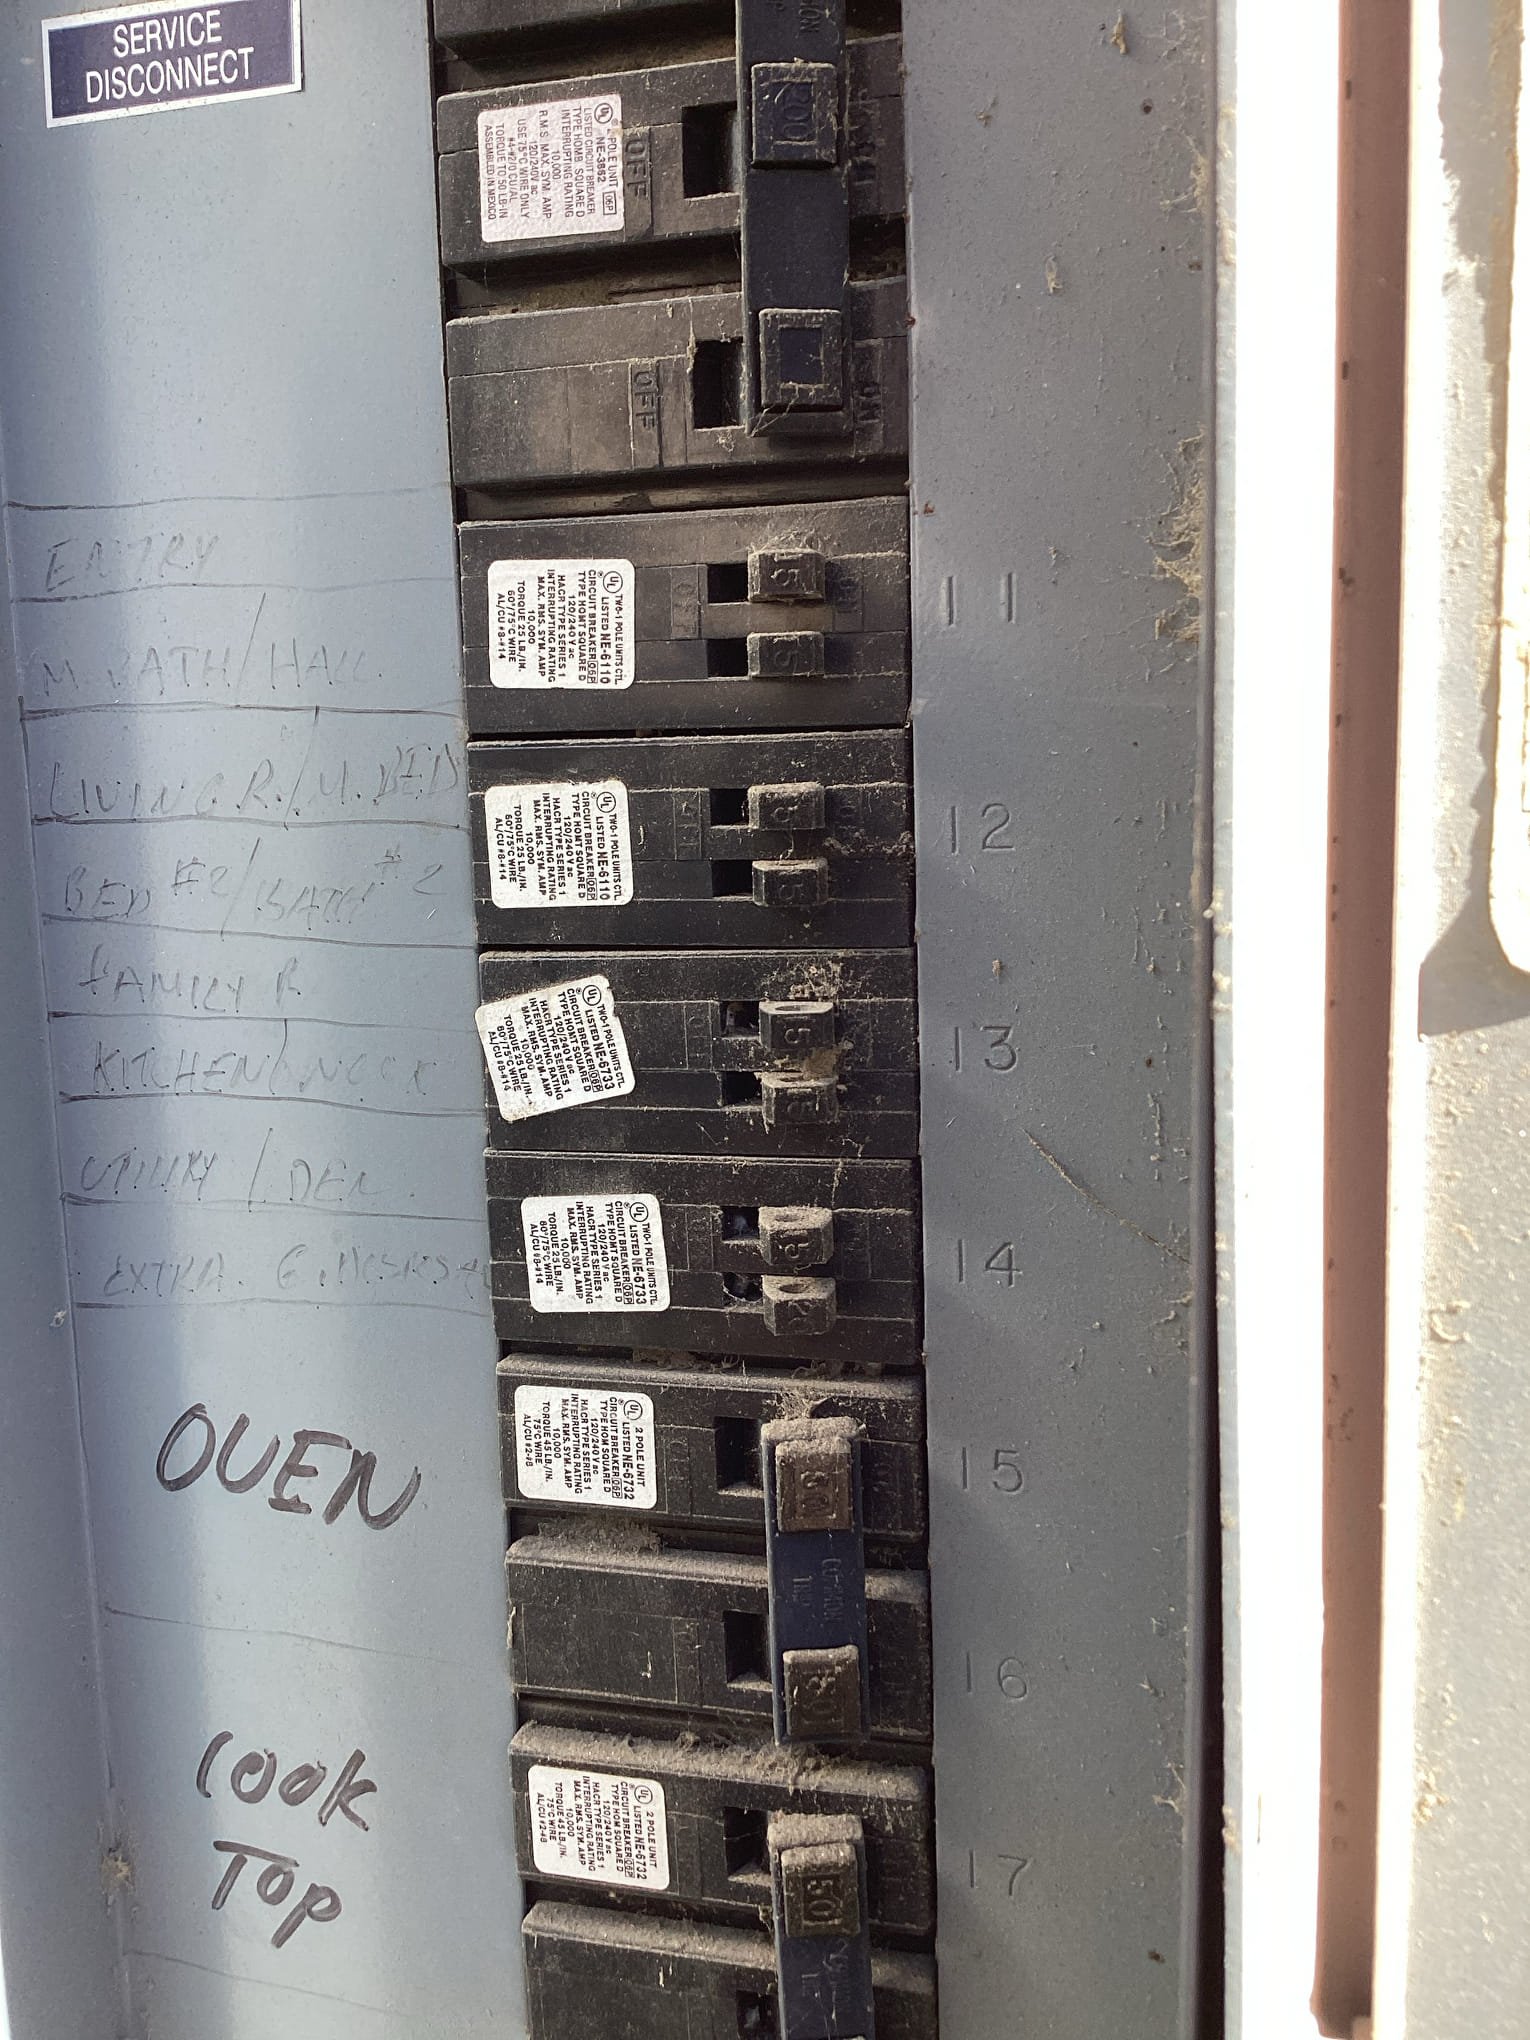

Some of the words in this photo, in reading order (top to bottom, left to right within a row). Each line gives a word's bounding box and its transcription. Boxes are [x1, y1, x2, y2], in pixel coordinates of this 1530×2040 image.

[113, 10, 222, 57] SERVICE
[86, 47, 254, 103] DISCONNECT
[584, 108, 593, 137] LISTED
[485, 125, 495, 174] ASSEMBLED
[496, 124, 505, 163] TORQUE
[562, 110, 572, 178] INTERRUPTING
[585, 140, 593, 171] CIRCUIT
[607, 138, 616, 163] POLE
[520, 166, 528, 191] WIRE
[551, 151, 561, 179] 10,000
[609, 165, 617, 187] UNIT
[625, 136, 648, 201] OFF
[488, 189, 496, 219] MEXICO
[521, 194, 529, 218] ONLY
[564, 182, 573, 217] RATING
[575, 169, 584, 207] SQUARE
[586, 176, 595, 214] BREAKER
[634, 368, 656, 430] OFF
[517, 581, 525, 621] TORQUE
[947, 572, 1015, 627] 11
[527, 610, 535, 644] 10,000
[601, 634, 611, 684] NE-6110
[514, 805, 523, 843] TORQUE
[543, 793, 554, 863] INTERRUPTING
[582, 791, 591, 830] CIRCUIT
[950, 802, 1015, 855] 12
[525, 832, 534, 865] 10,000
[552, 798, 561, 823] HACR
[557, 853, 565, 887] SERIES
[572, 793, 580, 817] TYPE
[576, 850, 584, 889] SQUARE
[596, 816, 605, 848] LISTED
[508, 859, 516, 882] WIRE
[585, 833, 594, 877] BREAKER
[547, 866, 556, 900] RATING
[597, 852, 610, 900] NE-6110
[504, 1015, 519, 1051] TORQUE
[539, 1000, 552, 1026] HACR
[554, 1053, 568, 1086] SERIES
[558, 992, 569, 1017] TYPE
[573, 1046, 588, 1083] SQUARE
[567, 988, 583, 1025] CIRCUIT
[578, 1028, 594, 1070] BREAKER
[521, 1039, 534, 1070] 10,000
[529, 998, 553, 1065] INTERRUPTING
[549, 1068, 563, 1100] RATING
[585, 1010, 599, 1041] LISTED
[593, 1042, 614, 1090] NE-6733
[953, 1024, 1019, 1073] 13
[509, 1068, 521, 1092] WIRE
[548, 1212, 560, 1248] TORQUE
[586, 1206, 596, 1231] HACR
[592, 1259, 602, 1291] SERIES
[605, 1202, 615, 1226] TYPE
[611, 1256, 621, 1293] SQUARE
[615, 1201, 625, 1237] CIRCUIT
[620, 1240, 630, 1282] BREAKER
[630, 1225, 639, 1255] LISTED
[560, 1238, 571, 1269] 10,000
[576, 1201, 589, 1267] INTERRUPTING
[584, 1271, 593, 1304] RATING
[957, 1239, 1022, 1289] 14
[544, 1263, 553, 1286] WIRE
[632, 1259, 646, 1304] NE-6733
[542, 1401, 551, 1438] TORQUE
[571, 1394, 581, 1458] INTERRUPTING
[581, 1399, 589, 1424] HACR
[600, 1400, 608, 1423] TYPE
[552, 1428, 561, 1458] 10,000
[622, 1422, 630, 1452] LISTED
[583, 1451, 591, 1482] SERIES
[602, 1448, 610, 1484] SQUARE
[611, 1436, 619, 1477] BREAKER
[961, 1447, 1024, 1494] 15
[574, 1462, 582, 1494] RATING
[623, 1454, 634, 1500] NE-6732
[965, 1651, 1029, 1700] 16
[555, 1782, 564, 1816] TORQUE
[583, 1776, 594, 1838] INTERRUPTING
[592, 1782, 601, 1805] HACR
[611, 1784, 620, 1805] TYPE
[620, 1782, 630, 1816] CIRCUIT
[565, 1808, 575, 1837] 10,000
[623, 1818, 632, 1857] BREAKER
[633, 1806, 642, 1834] LISTED
[586, 1841, 596, 1871] RATING
[596, 1832, 604, 1861] SERIES
[614, 1830, 623, 1864] SQUARE
[635, 1837, 647, 1879] NE-6732
[969, 1848, 1033, 1897] 17
